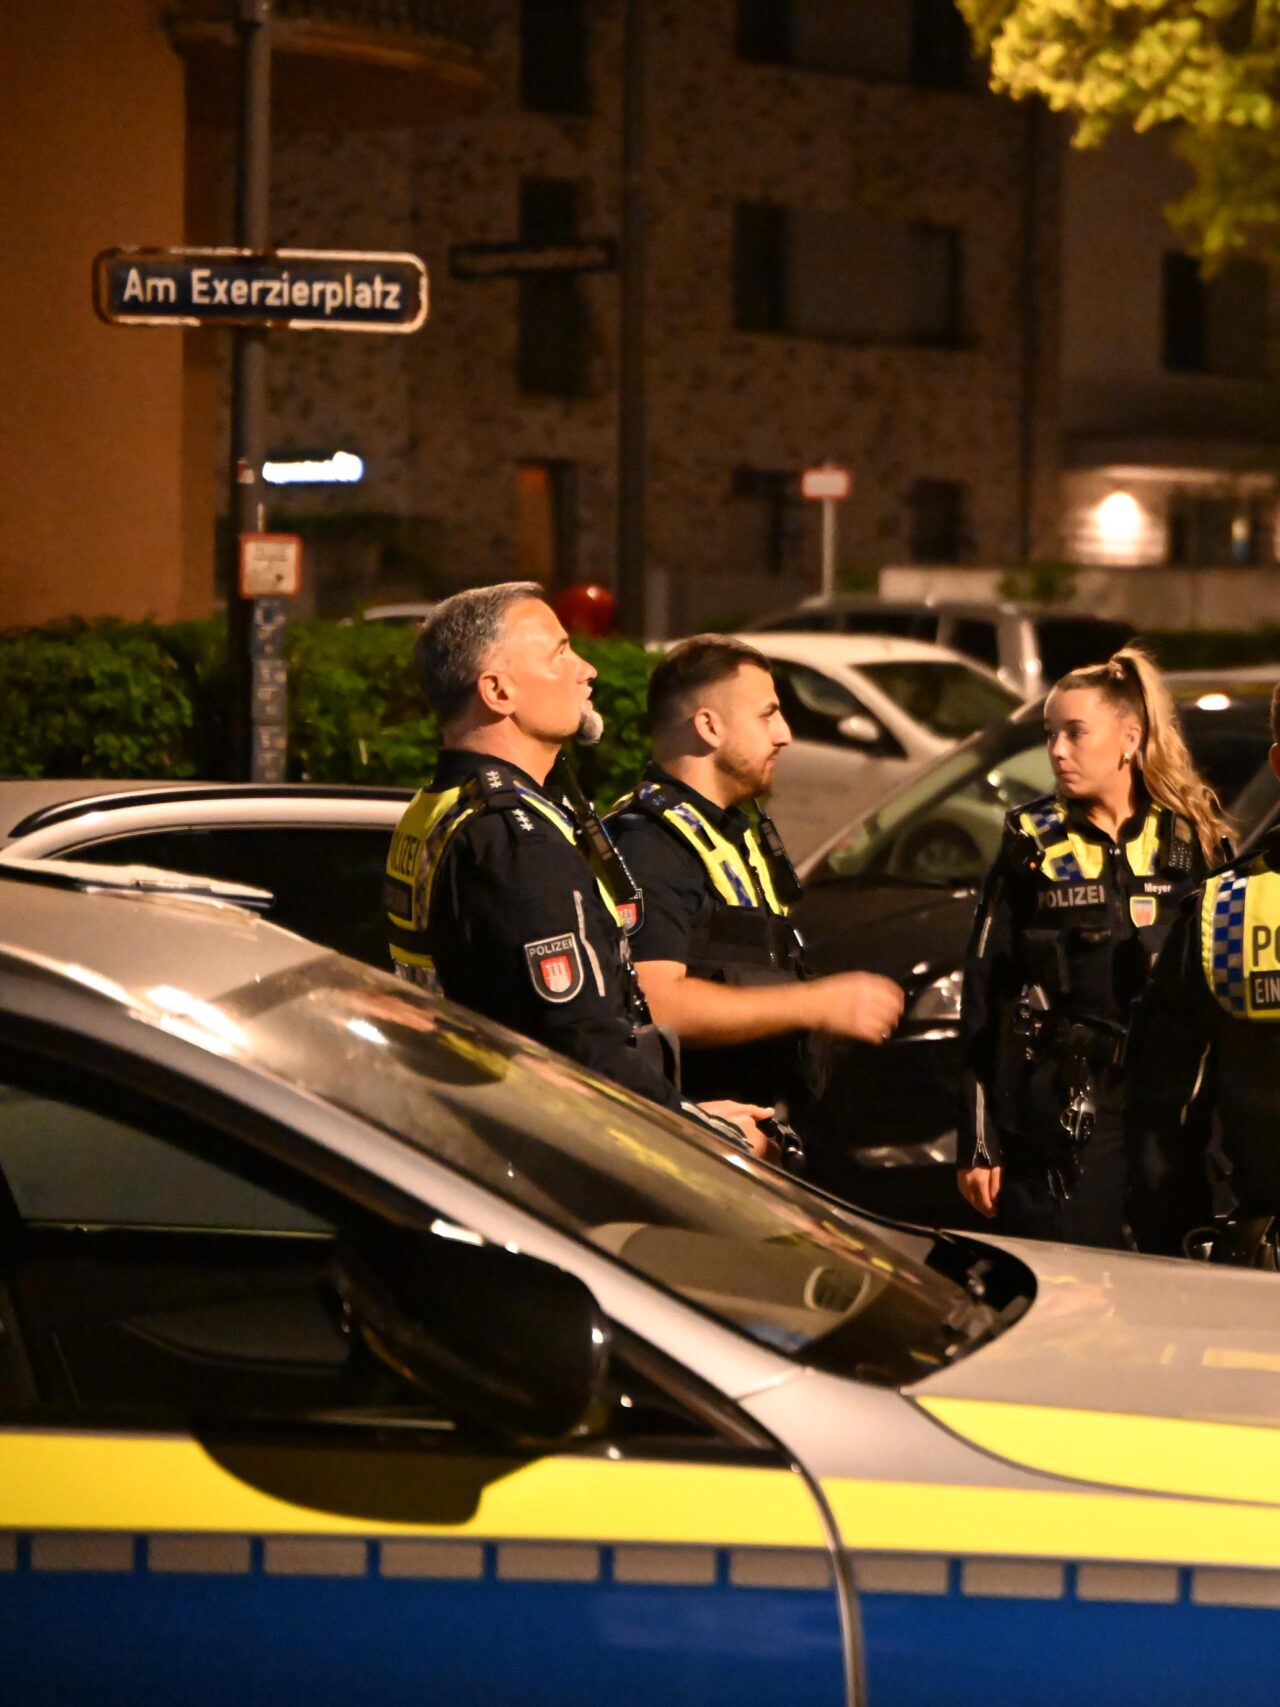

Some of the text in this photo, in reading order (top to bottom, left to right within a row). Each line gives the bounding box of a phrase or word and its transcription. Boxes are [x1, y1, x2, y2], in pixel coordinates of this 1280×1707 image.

[122, 267, 401, 315] Am Exerzierplatz
[1144, 882, 1172, 895] Meyer
[528, 938, 573, 957] POLIZEI
